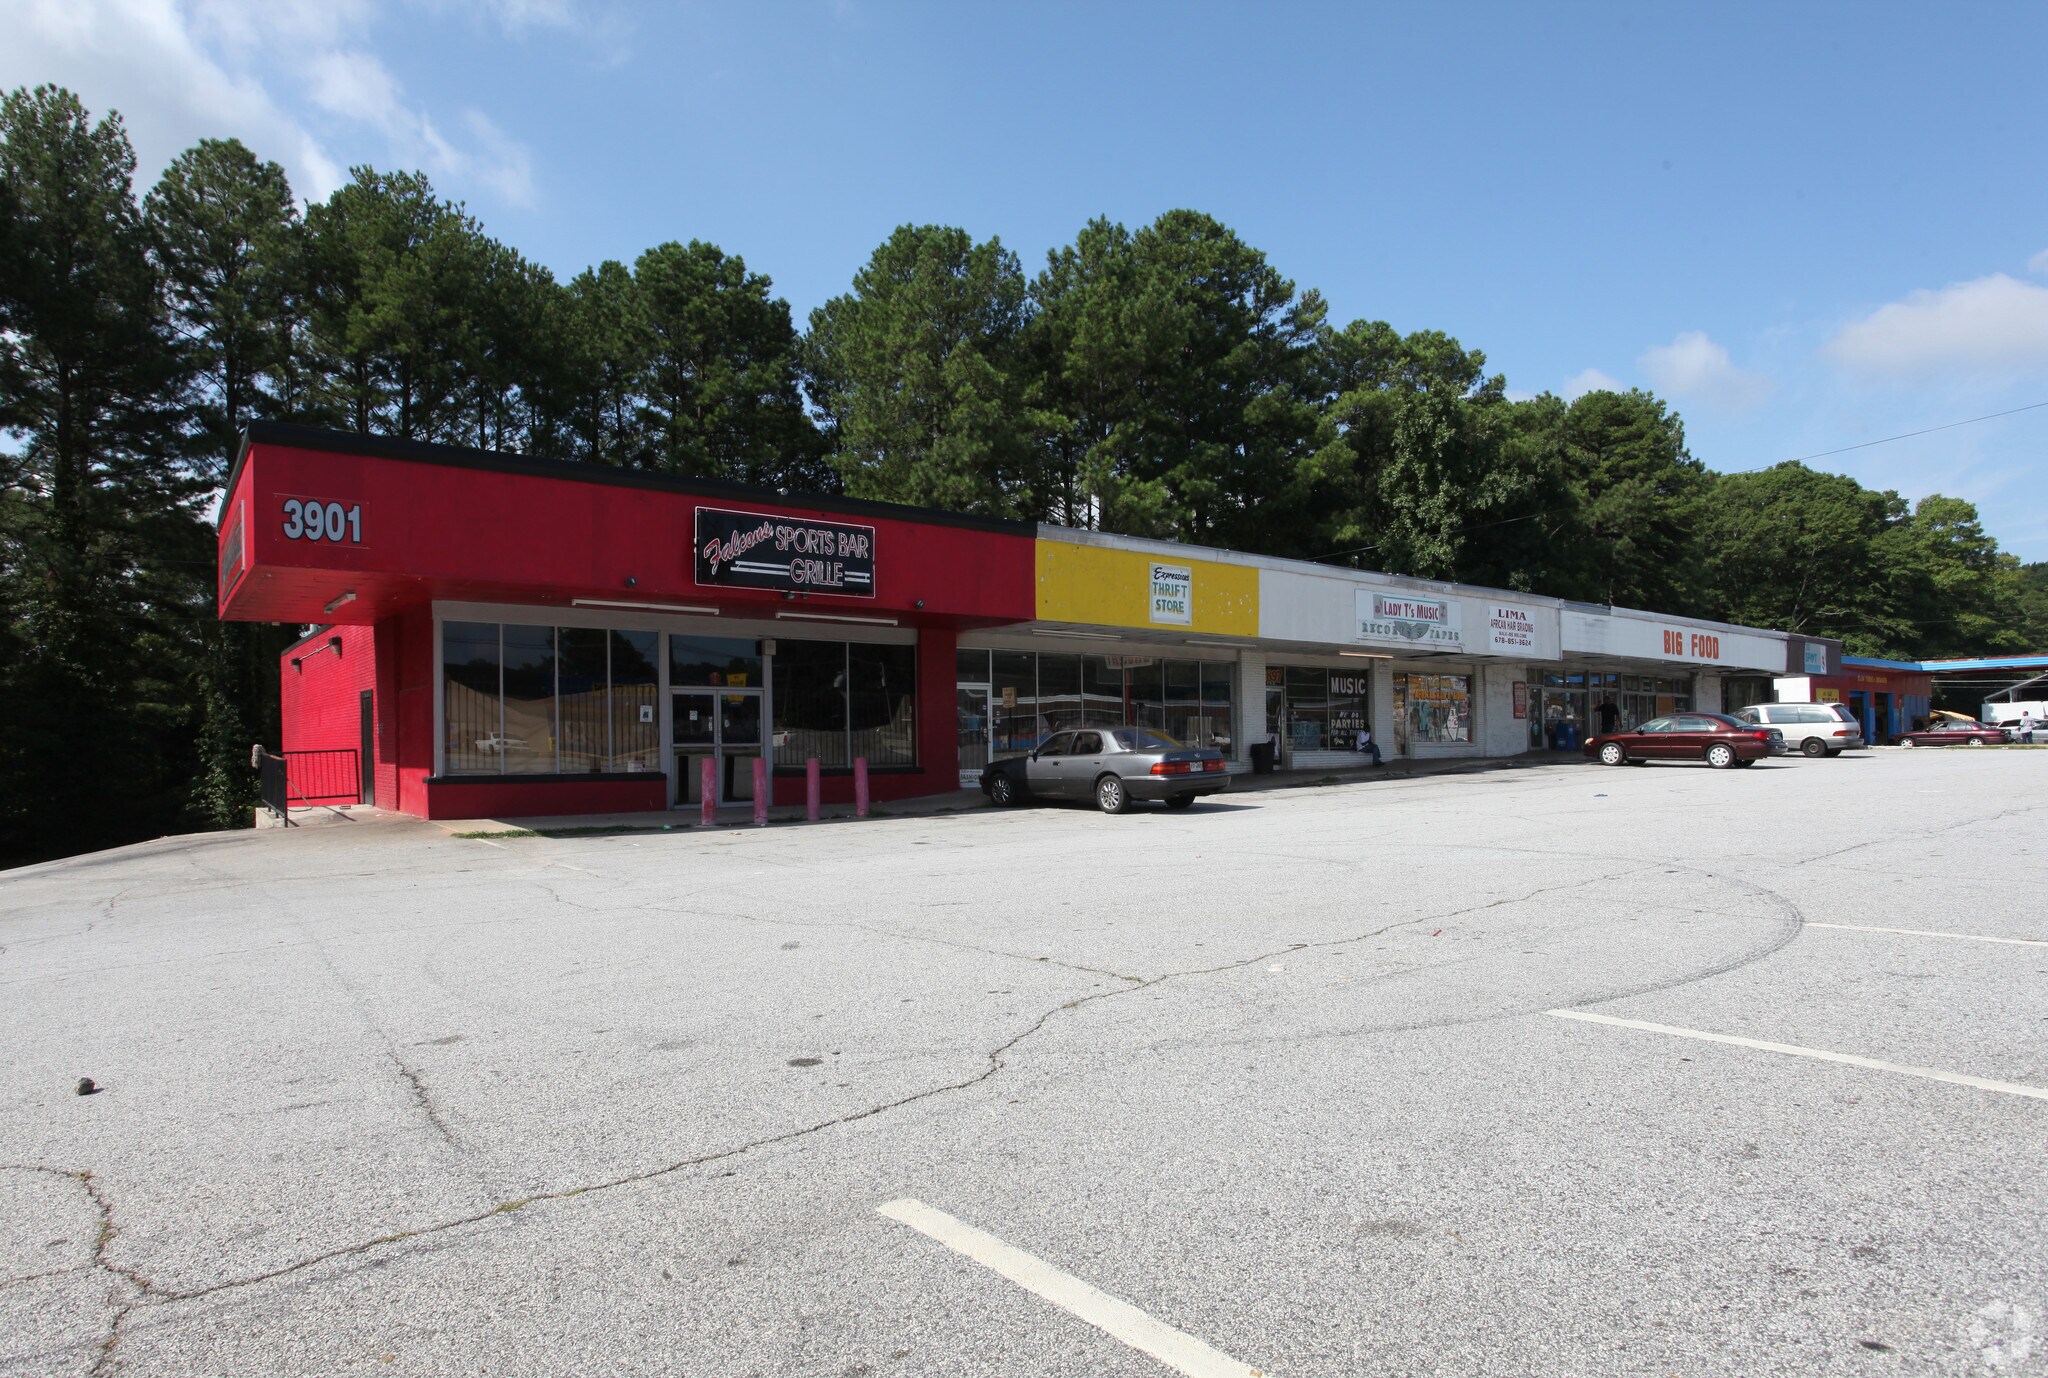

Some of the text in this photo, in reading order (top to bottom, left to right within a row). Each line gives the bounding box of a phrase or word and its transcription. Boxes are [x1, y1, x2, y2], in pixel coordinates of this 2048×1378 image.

[283, 498, 361, 543] 3901
[775, 525, 835, 556] SPORTS
[838, 532, 868, 559] BAR
[790, 557, 843, 586] GRILLE
[1153, 566, 1190, 581] Expressions
[1152, 581, 1188, 599] THRIFT
[1155, 598, 1185, 614] STORE
[1383, 601, 1439, 620] LADY T's MUSIC
[1498, 608, 1527, 621] LIMA
[1429, 629, 1460, 641] TAPES
[1494, 636, 1532, 647] 678-851-3624
[1663, 629, 1719, 660] BIG FOOD
[1331, 677, 1366, 694] MUSIC
[1331, 719, 1365, 729] PARTIES
